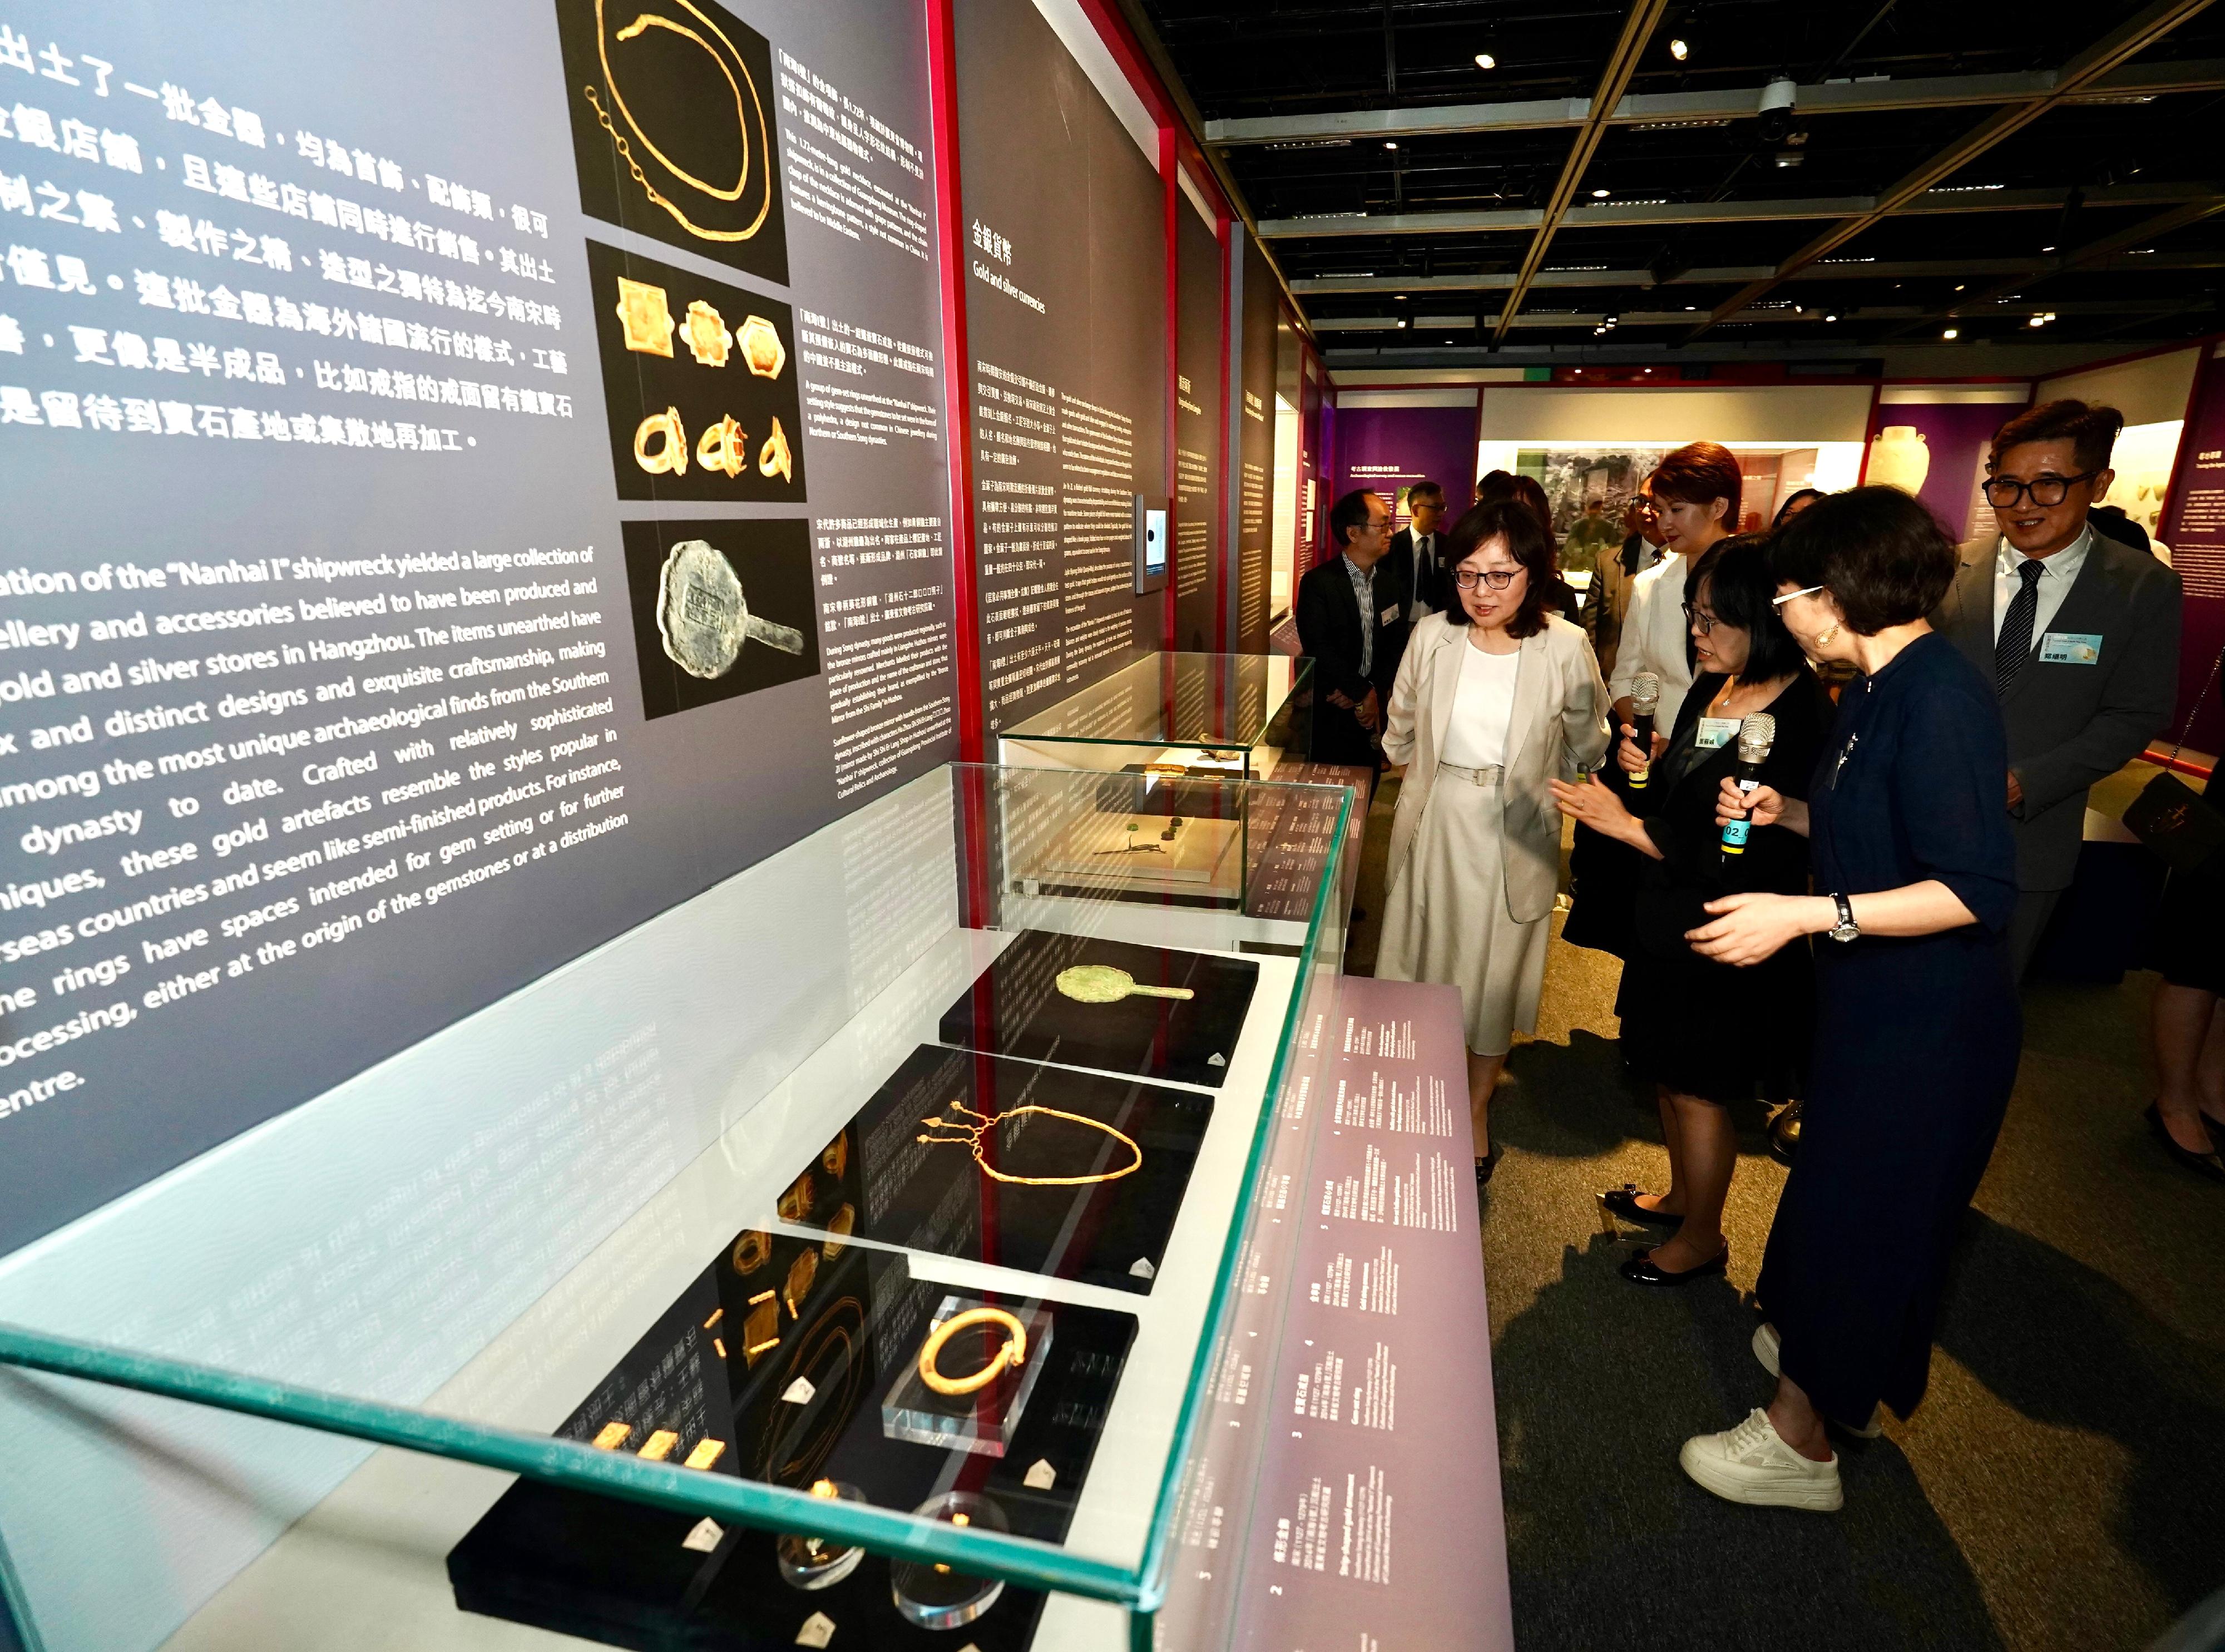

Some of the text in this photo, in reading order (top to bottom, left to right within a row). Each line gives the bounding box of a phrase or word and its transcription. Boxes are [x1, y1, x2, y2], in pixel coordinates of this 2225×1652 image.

[972, 219, 1012, 266] 金銀貨幣
[973, 260, 1045, 314] Gold and silver currencies
[81, 562, 113, 591] of
[115, 562, 166, 589] the
[292, 553, 396, 583] shipwreck
[394, 550, 460, 578] yielded
[461, 555, 472, 570] a
[472, 550, 512, 572] large
[513, 547, 579, 567] collection
[580, 545, 594, 563] of
[90, 610, 148, 641] and
[156, 602, 295, 634] accessories
[299, 592, 387, 620] believed
[390, 594, 412, 612] to
[414, 590, 457, 610] have
[459, 586, 501, 606] been
[504, 578, 571, 606] produced
[573, 577, 597, 595] and
[31, 715, 93, 749] and
[105, 701, 210, 737] distinct
[217, 688, 308, 718] designs
[315, 675, 356, 702] and
[363, 665, 443, 694] exquisite
[448, 647, 555, 679] craftsmanship,
[558, 640, 606, 660] making
[62, 661, 123, 694] and
[127, 657, 200, 685] silver
[205, 650, 279, 675] stores
[281, 644, 305, 665] in
[308, 632, 416, 661] Hangzhou.
[414, 626, 449, 647] The
[451, 624, 496, 642] items
[497, 611, 570, 636] unearthed
[571, 610, 601, 626] have
[0, 671, 609, 808] mong the most unique archaeological finds from the Southern
[21, 696, 613, 855] dynasty to date. Crafted with relatively sophisticated
[78, 883, 209, 937] countries
[212, 862, 259, 896] and
[262, 849, 322, 881] seem
[323, 837, 360, 860] like
[362, 797, 477, 849] semi-finished
[478, 782, 545, 816] products.
[545, 773, 567, 791] For
[568, 758, 621, 784] instance,
[120, 842, 198, 877] these
[212, 817, 269, 857] gold
[282, 795, 372, 833] artefacts
[382, 769, 461, 805] resemble
[468, 761, 496, 780] the
[503, 748, 543, 771] styles
[550, 733, 599, 761] popular
[605, 728, 617, 742] in
[53, 954, 130, 995] rings
[142, 928, 209, 963] have
[221, 897, 299, 937] spaces
[308, 858, 398, 906] intended
[406, 852, 431, 872] for
[439, 837, 476, 864] gem
[483, 817, 533, 844] setting
[539, 809, 554, 824] or
[560, 800, 578, 817] for
[584, 785, 625, 809] further
[144, 966, 220, 1008] either
[228, 953, 254, 977] at
[256, 939, 296, 965] the
[301, 914, 362, 948] origin
[367, 898, 387, 923] of
[390, 892, 422, 914] the
[425, 858, 511, 905] gemstones
[513, 850, 528, 866] or
[532, 842, 546, 859] at
[549, 840, 558, 853] a
[560, 813, 628, 848] distribution
[1270, 1585, 1283, 1595] 2
